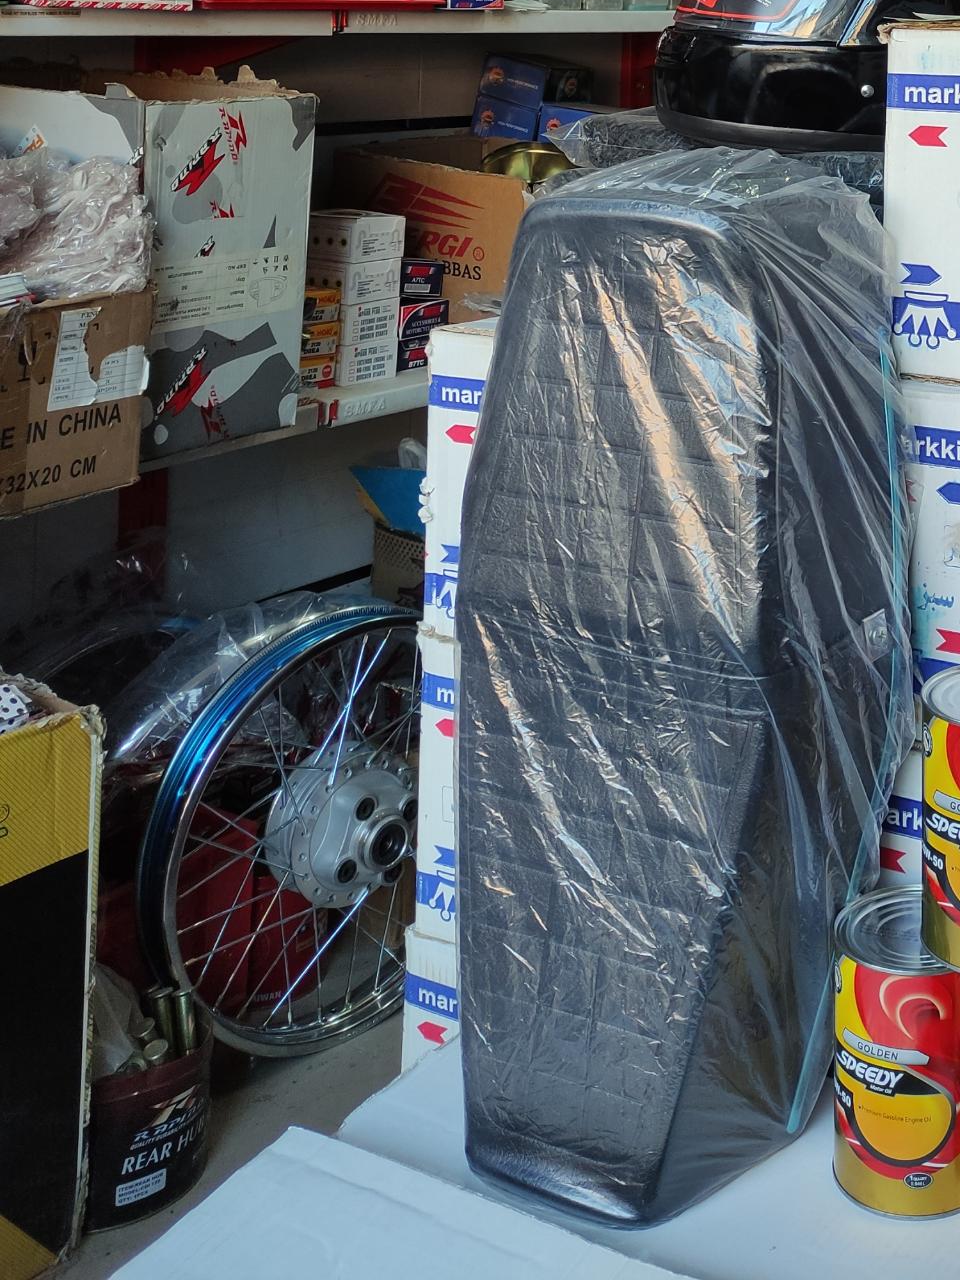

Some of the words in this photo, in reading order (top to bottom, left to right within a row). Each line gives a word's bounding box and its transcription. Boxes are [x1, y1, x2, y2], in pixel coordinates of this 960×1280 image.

[26, 419, 48, 445] IN
[58, 403, 122, 437] CHINA
[70, 455, 97, 479] CM
[857, 1040, 899, 1061] GOLDEN
[836, 1049, 905, 1089] SPEEDY
[882, 1112, 905, 1122] Gasoline
[904, 1116, 924, 1125] Engine
[121, 1141, 172, 1176] REAR
